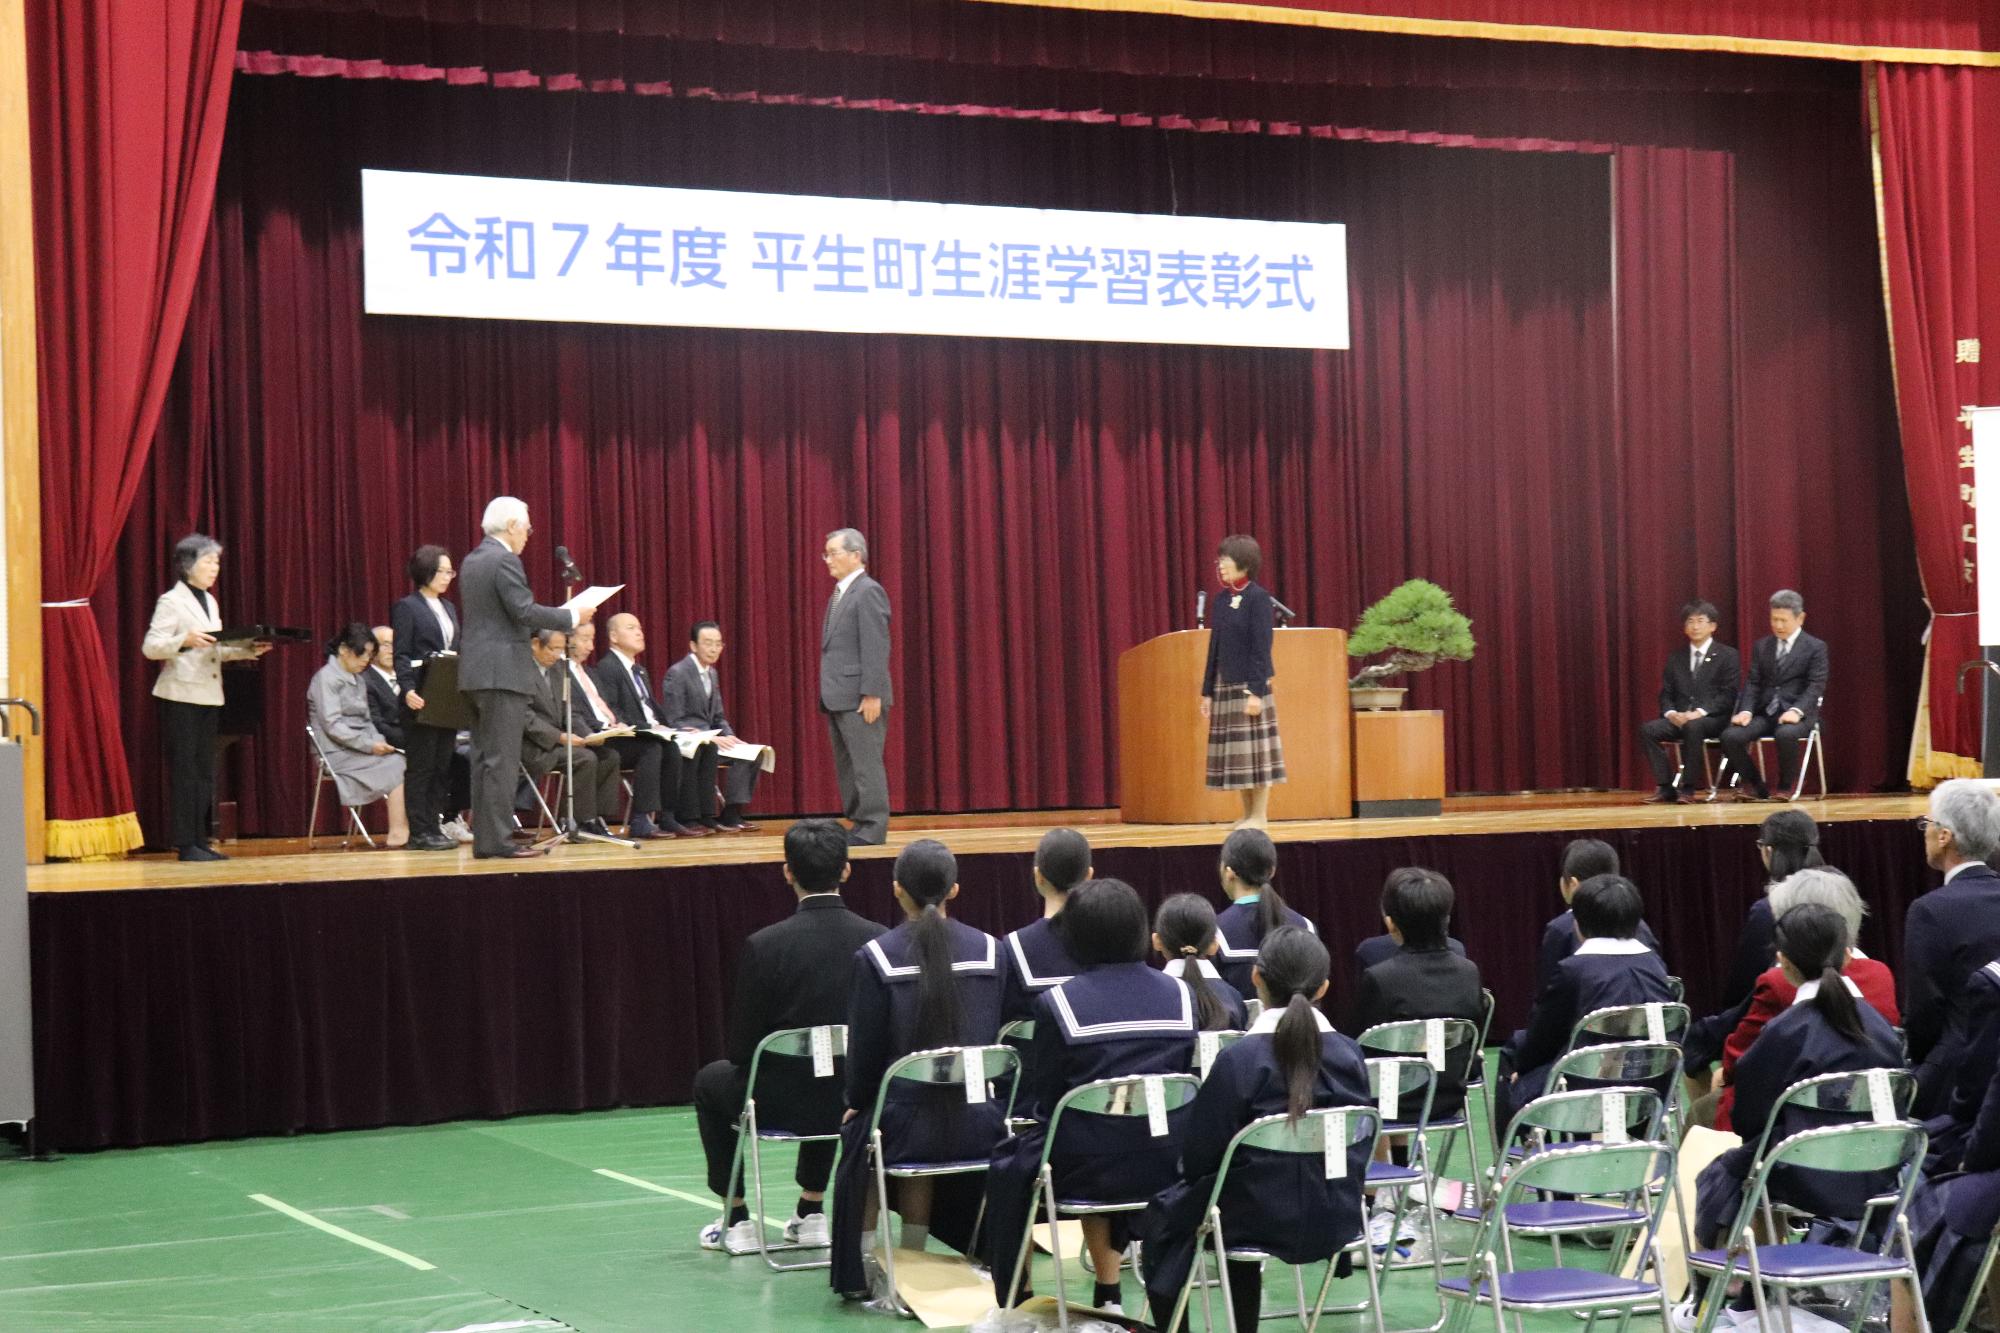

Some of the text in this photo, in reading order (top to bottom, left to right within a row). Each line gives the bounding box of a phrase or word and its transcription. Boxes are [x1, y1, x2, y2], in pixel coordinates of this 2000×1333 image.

[407, 211, 1316, 313] 令和7年度 平生町生涯学習表彰式
